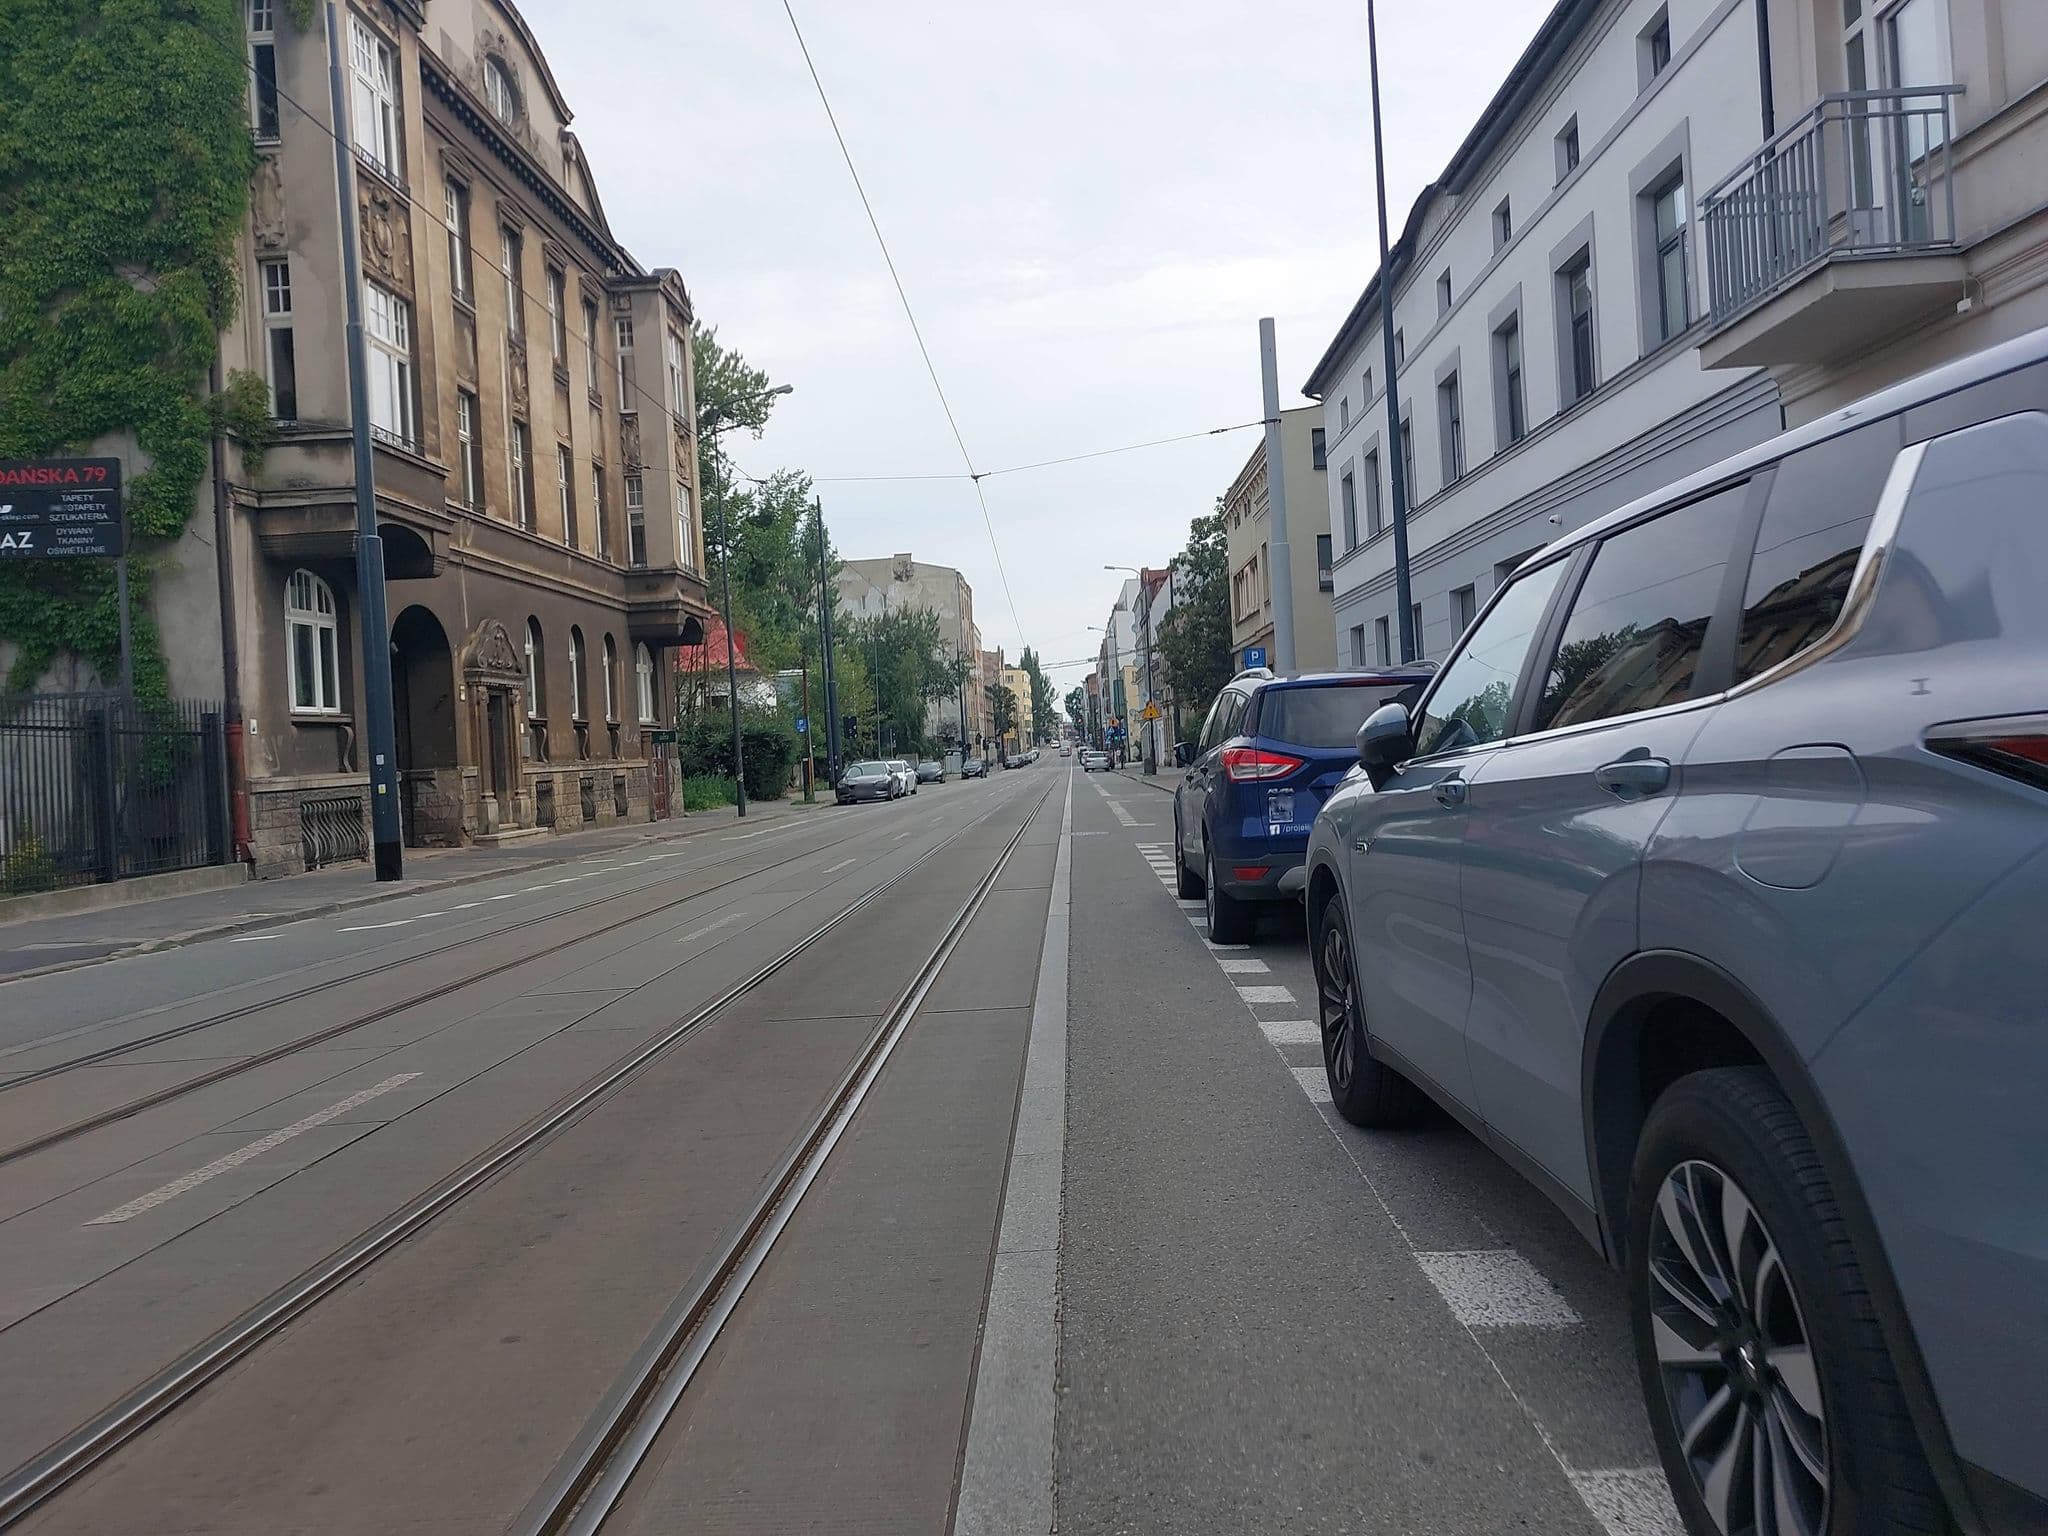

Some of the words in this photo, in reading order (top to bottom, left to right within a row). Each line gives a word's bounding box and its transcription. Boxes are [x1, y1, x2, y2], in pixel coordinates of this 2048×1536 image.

[82, 467, 107, 482] 79
[61, 494, 94, 502] TAPETY
[48, 503, 107, 512] OTAPETY
[48, 512, 109, 522] SZTUKATERIA
[56, 527, 94, 536] DYWANY
[57, 537, 95, 545] TKANINY
[1251, 650, 1259, 662] P
